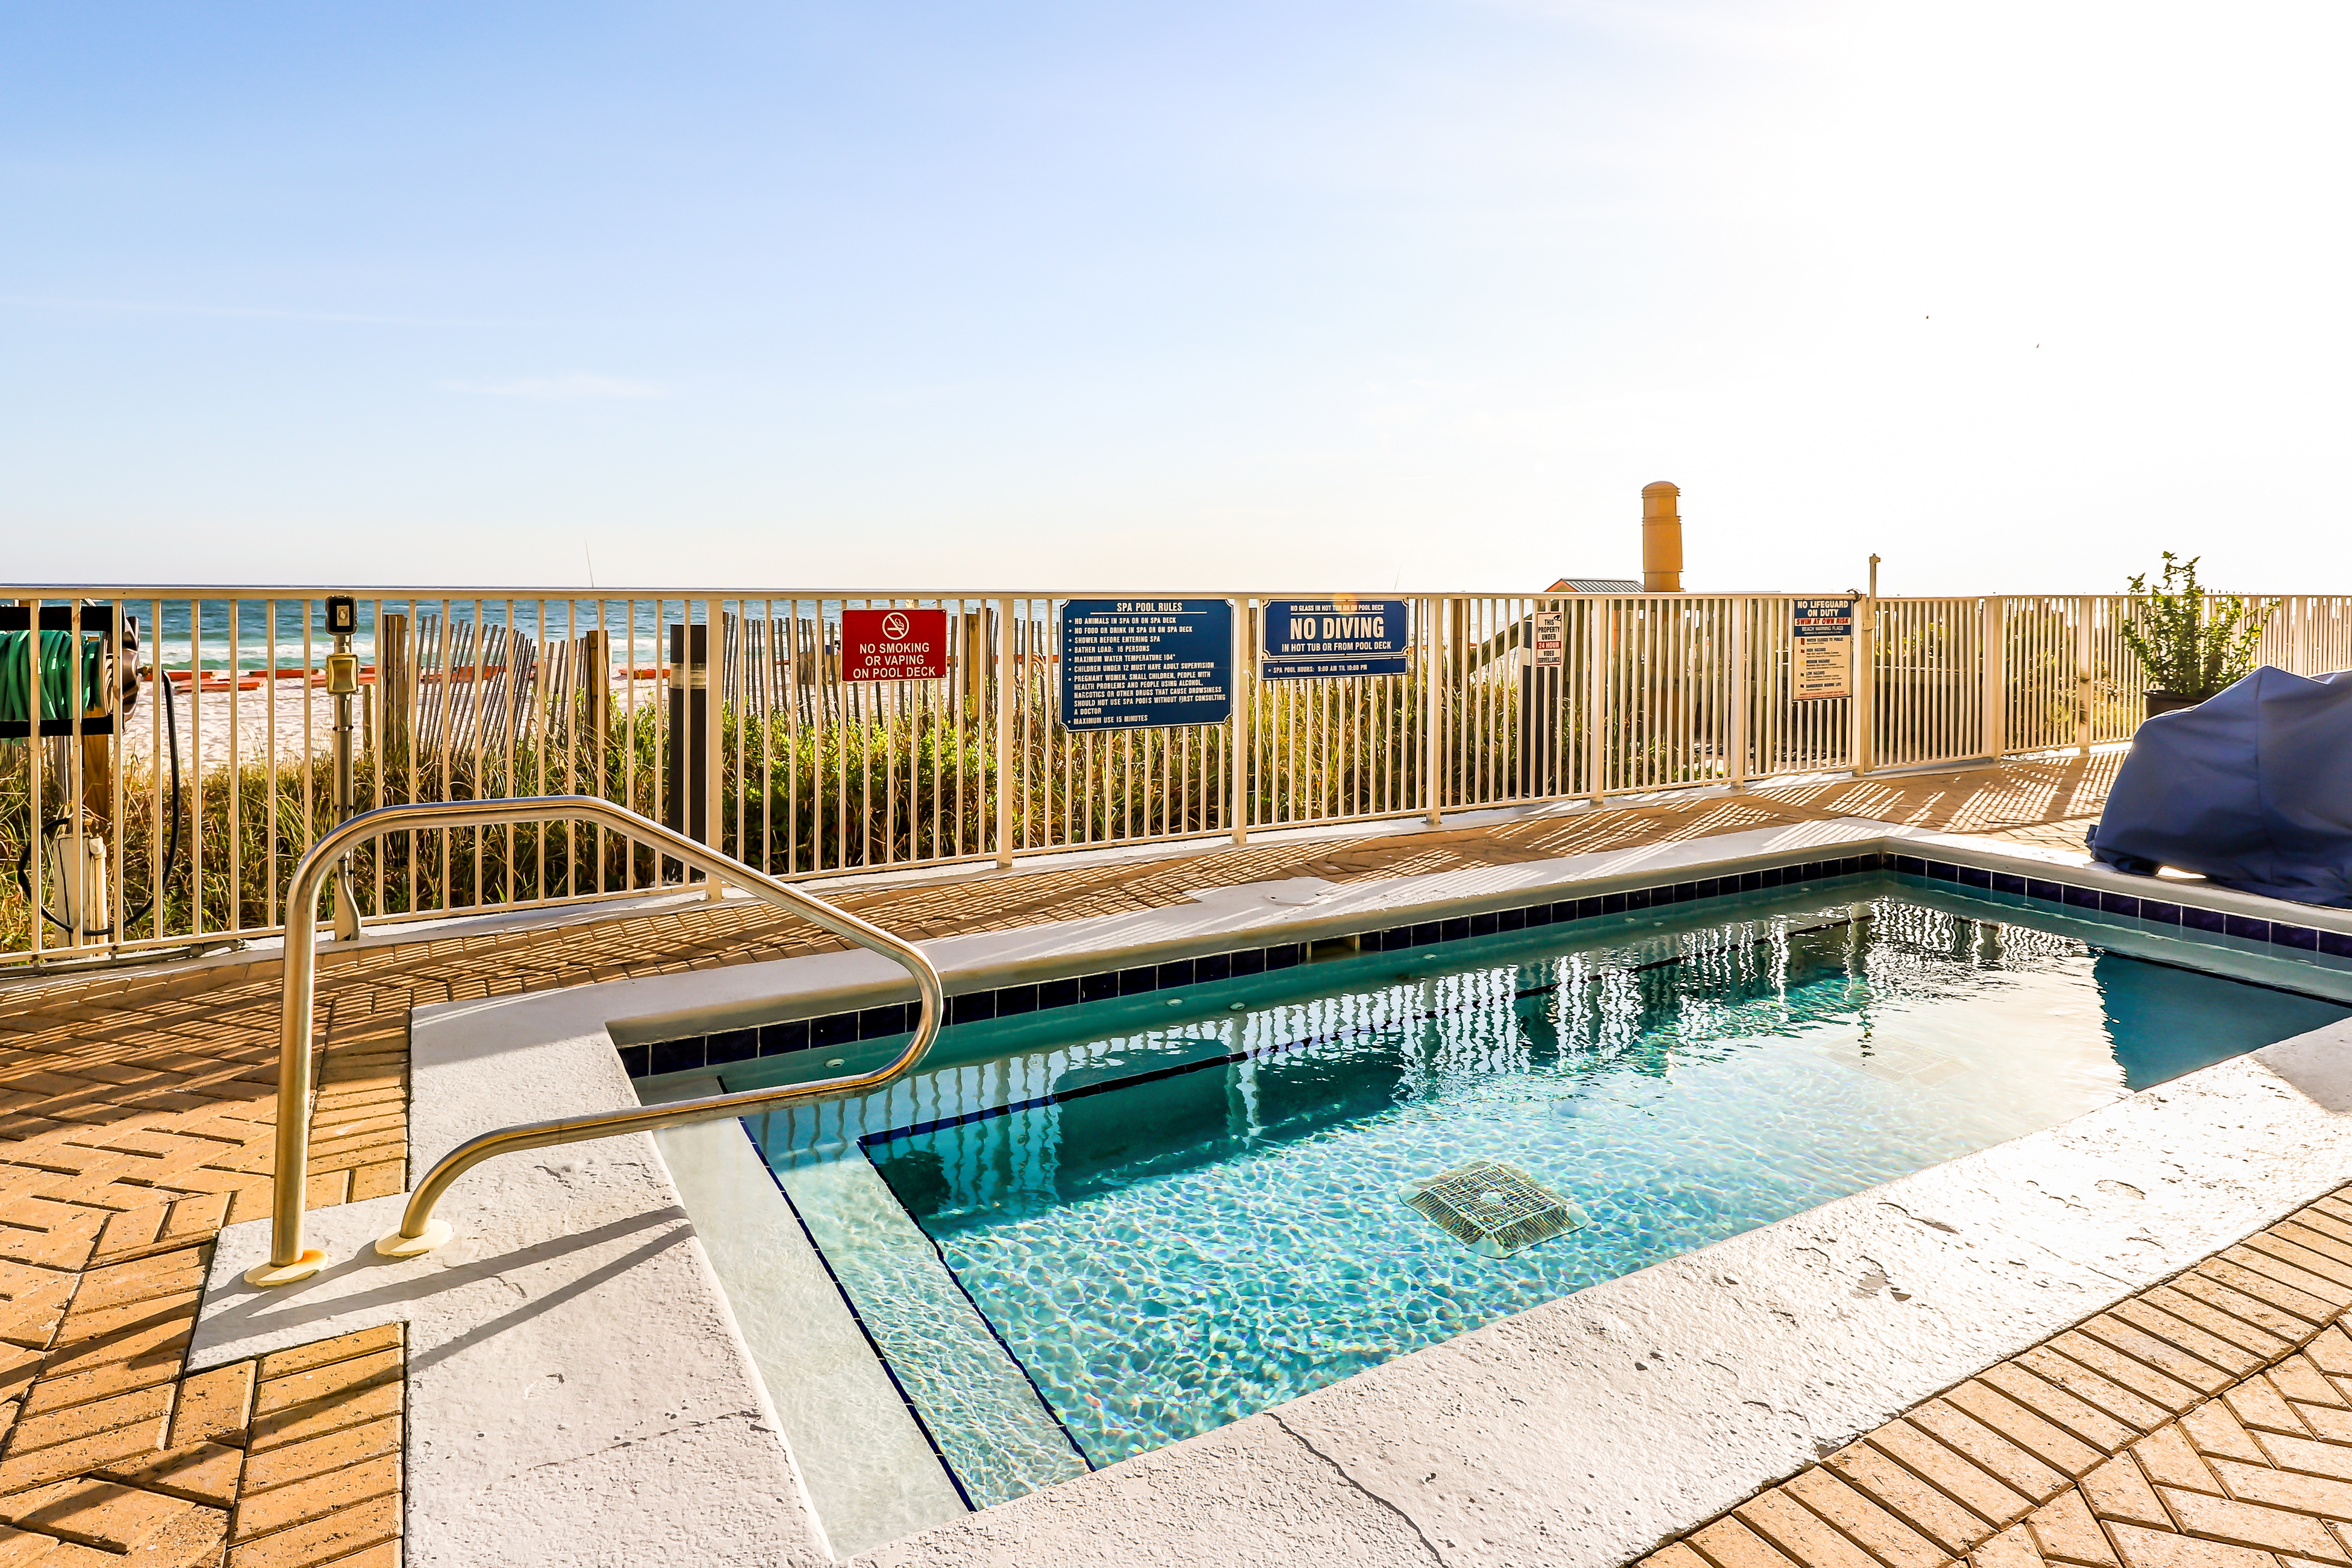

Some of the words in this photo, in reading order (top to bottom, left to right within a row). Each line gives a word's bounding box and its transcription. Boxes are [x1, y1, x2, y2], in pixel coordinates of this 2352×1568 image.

[1116, 602, 1133, 612] SPA
[1135, 602, 1155, 612] POOL
[1158, 602, 1183, 612] RULES
[1820, 609, 1839, 617] DUTY
[1290, 618, 1316, 640] NO
[1323, 616, 1384, 639] DIVING
[859, 643, 876, 654] NO
[879, 642, 929, 654] SMOKING
[1282, 643, 1289, 653] IN
[1291, 643, 1305, 652] HOT
[1306, 642, 1321, 652] TUB
[1322, 642, 1332, 651] OR
[1333, 642, 1353, 651] FROM
[1355, 642, 1373, 650] POOL
[1374, 641, 1392, 650] DECK
[865, 656, 881, 666] OR
[884, 654, 924, 666] VAPING
[852, 668, 869, 679] ON
[873, 667, 903, 678] POOL
[906, 666, 936, 677] DECK
